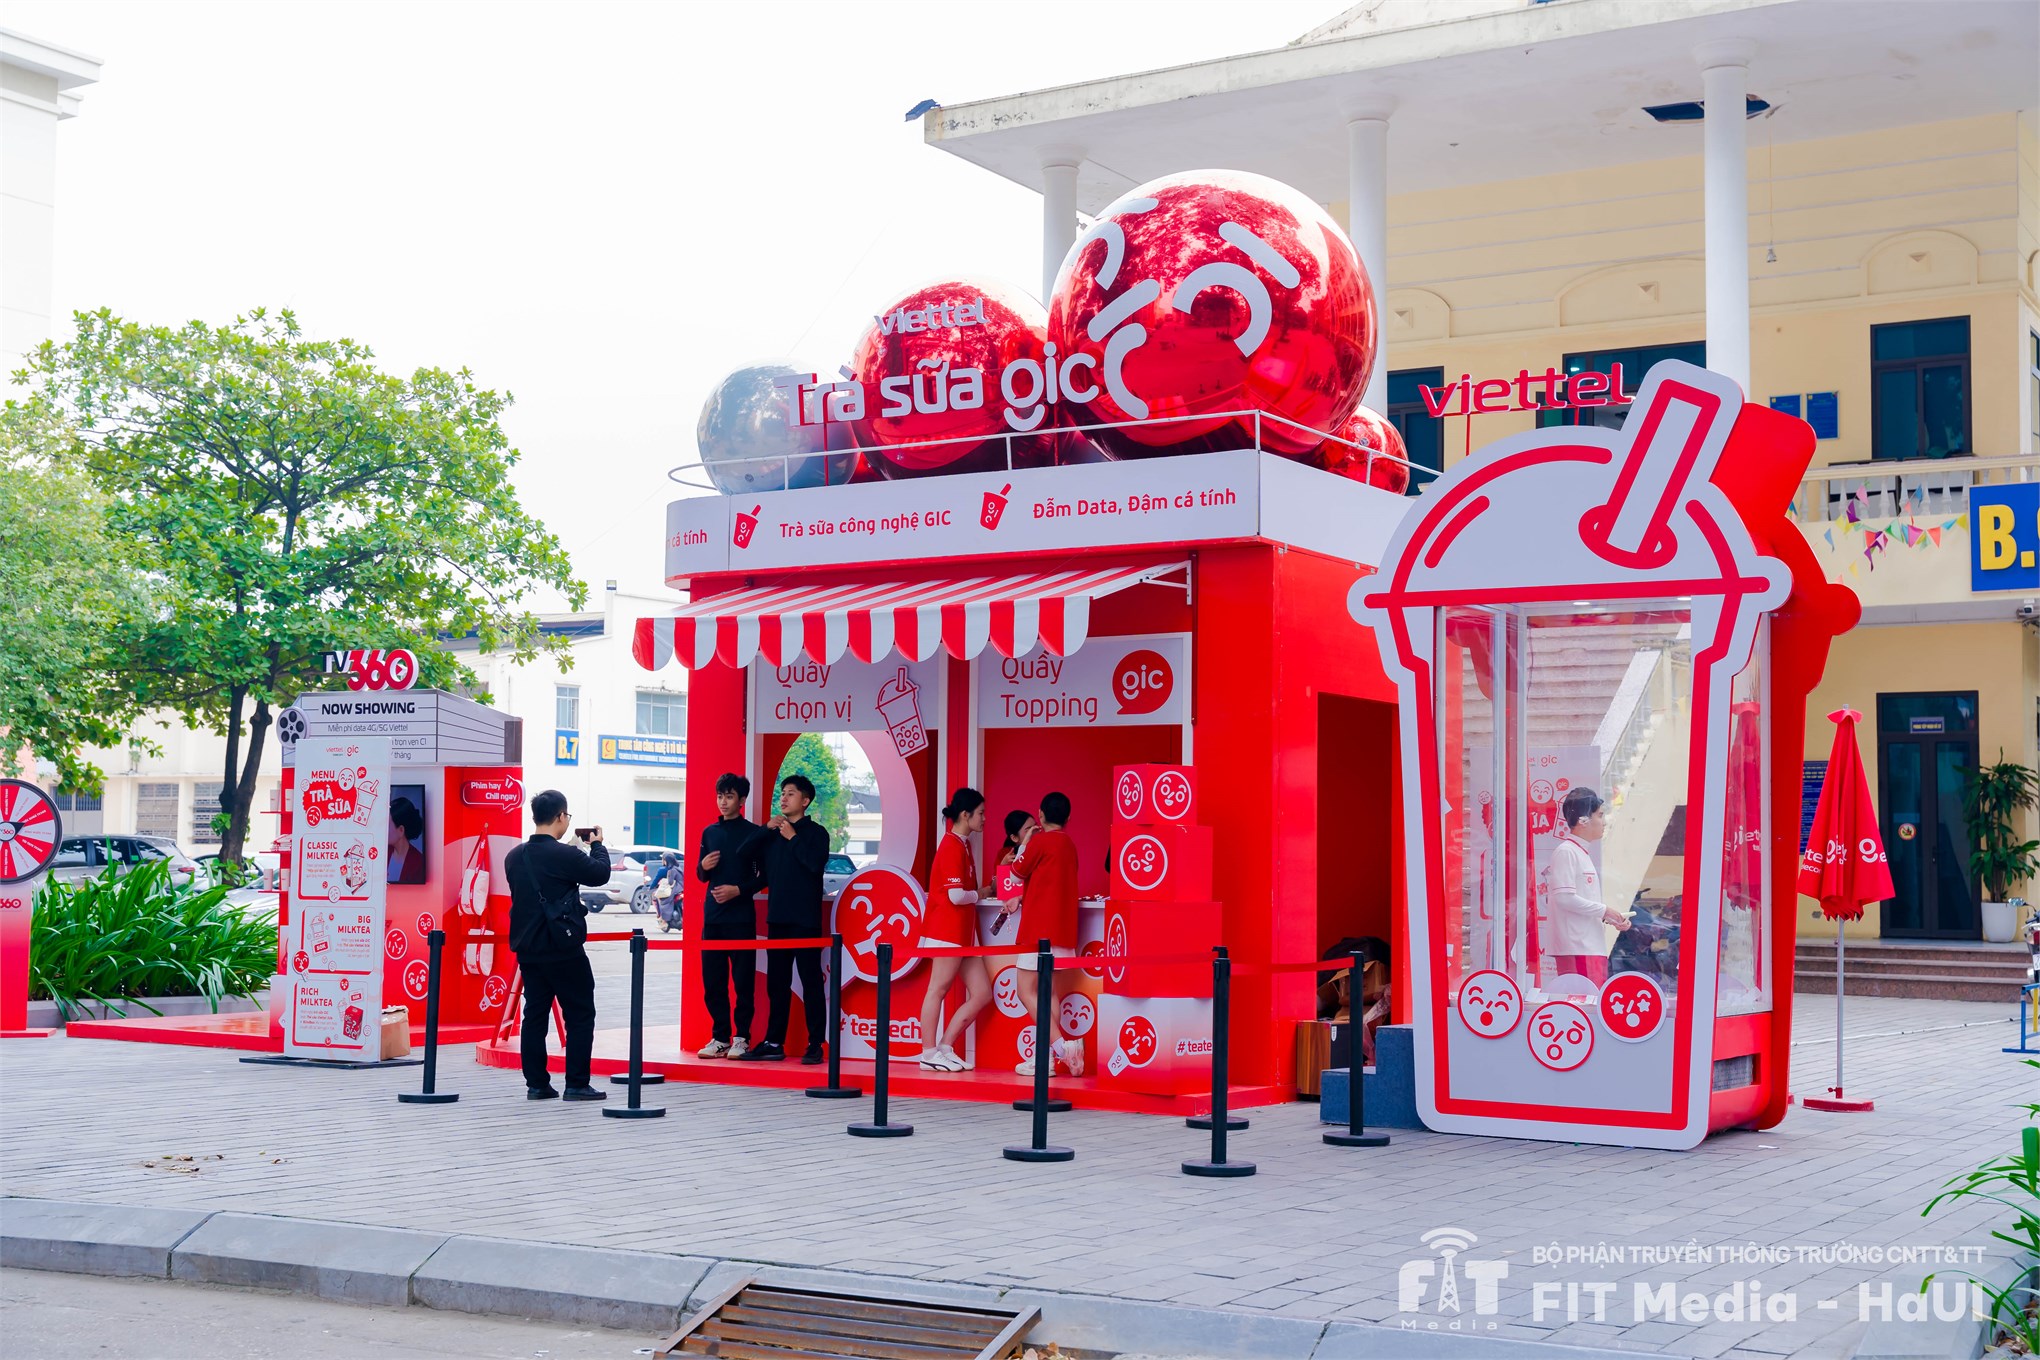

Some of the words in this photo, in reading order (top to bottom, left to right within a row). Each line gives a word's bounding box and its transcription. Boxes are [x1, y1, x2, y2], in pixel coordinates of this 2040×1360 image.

[874, 298, 990, 335] viettel
[774, 364, 866, 428] Trà
[881, 356, 984, 419] sữa
[1001, 341, 1100, 431] gic
[1418, 362, 1635, 417] viettel
[1033, 497, 1072, 519] Đẫm
[1077, 499, 1123, 516] Data,
[1128, 493, 1168, 514] Đậm
[1174, 490, 1194, 509] cá
[1199, 487, 1237, 507] tính
[779, 520, 804, 538] Trà
[808, 519, 835, 536] sữa
[839, 516, 876, 536] công
[880, 511, 920, 535] nghệ
[924, 510, 951, 528] GIC
[683, 529, 707, 545] tính
[1978, 504, 2040, 570] B.
[318, 648, 420, 692] TV360
[1001, 649, 1064, 685] Quầy
[1121, 664, 1164, 700] gic
[321, 703, 353, 715] NOW
[355, 702, 415, 715] SHOWING
[775, 695, 827, 723] chọn
[834, 694, 852, 723] vị
[1000, 692, 1099, 724] Topping
[353, 724, 366, 732] data
[389, 723, 409, 732] Viettel
[557, 736, 579, 760] B.7
[1541, 755, 1558, 768] gic
[311, 770, 335, 779] MENU
[309, 784, 333, 803] TRÀ
[470, 781, 488, 790] Phim
[488, 781, 502, 791] hay
[485, 792, 500, 801] Chill
[500, 793, 518, 802] ngay
[327, 798, 352, 816] SỮA
[307, 841, 338, 850] CLASSIC
[306, 851, 340, 860] MILKTEA
[357, 915, 371, 924] BIG
[337, 925, 371, 934] MILKTEA
[300, 987, 319, 996] RICH
[300, 998, 333, 1007] MILKTEA
[850, 1017, 922, 1039] teaech
